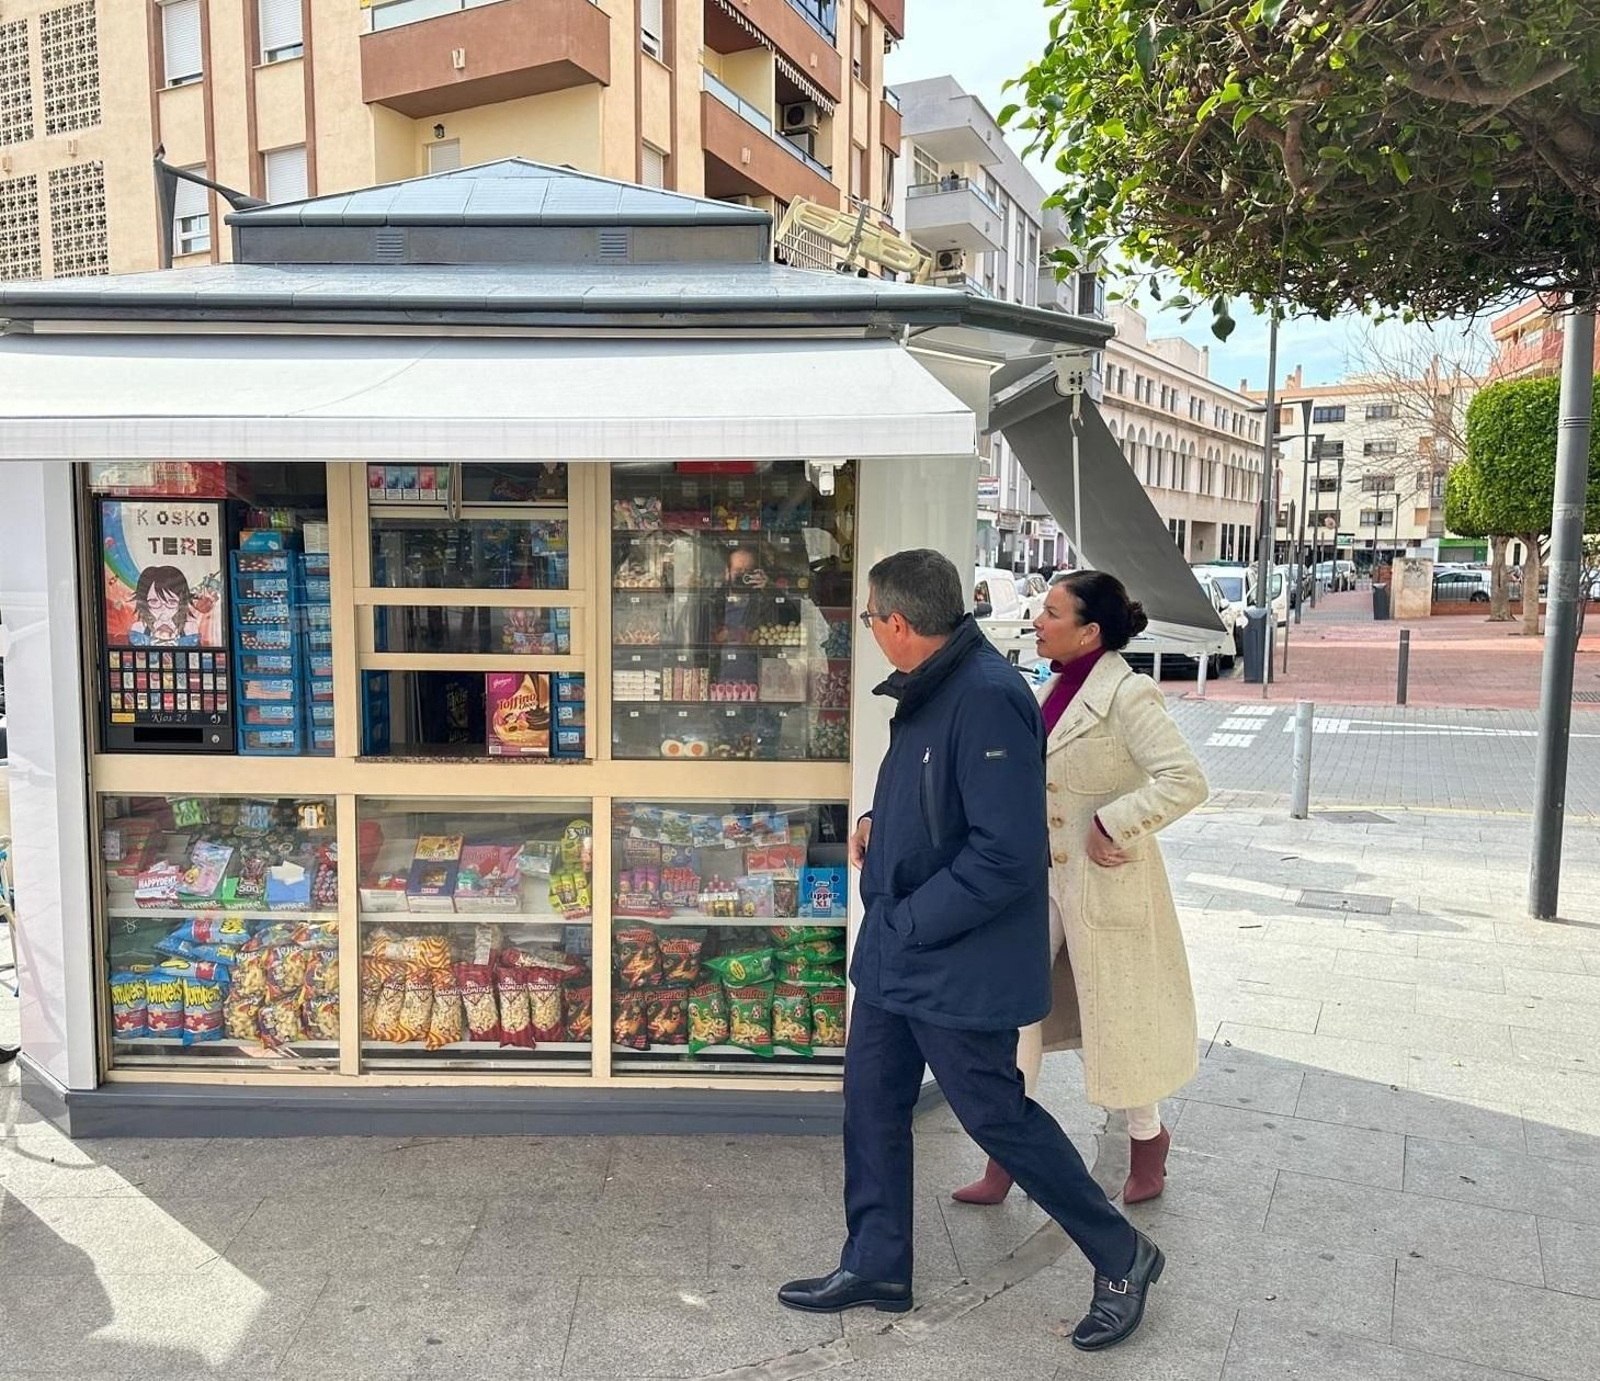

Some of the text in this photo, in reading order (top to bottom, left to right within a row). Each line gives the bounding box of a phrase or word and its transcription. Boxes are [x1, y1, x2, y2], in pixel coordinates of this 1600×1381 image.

[137, 509, 210, 526] KOSKO
[148, 537, 212, 556] TERE
[497, 693, 536, 711] Toffino
[151, 714, 188, 723] Kios 24
[138, 876, 177, 889] HAPPYDENT
[816, 900, 828, 908] XL
